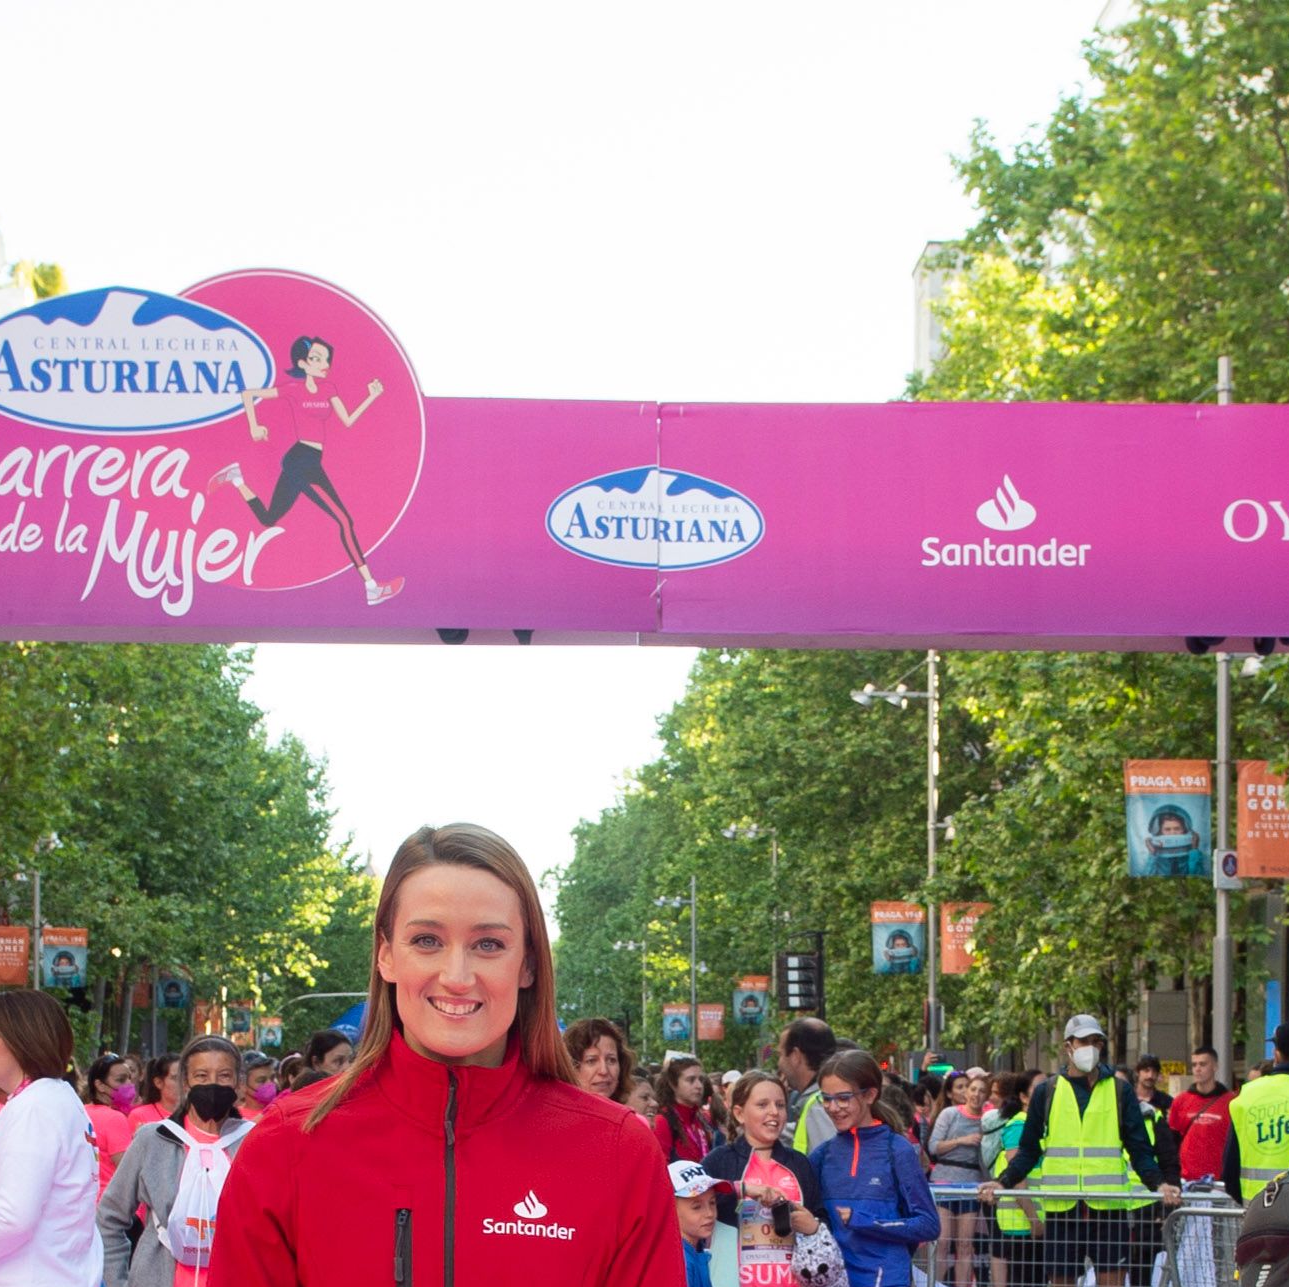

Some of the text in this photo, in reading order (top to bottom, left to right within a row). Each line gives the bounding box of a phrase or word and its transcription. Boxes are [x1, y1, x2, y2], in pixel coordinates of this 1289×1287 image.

[34, 336, 239, 352] CENTRAL LECHERA
[597, 500, 741, 514] CENTRAL LECHERA
[563, 502, 748, 543] ASTURIANA
[54, 502, 89, 555] la
[81, 495, 286, 618] Mujer
[921, 536, 1091, 567] Santander
[1130, 775, 1207, 788] PRAGA, 1941
[1248, 1100, 1289, 1124] Sport
[482, 1218, 576, 1240] Santander
[740, 1265, 797, 1285] SUM
